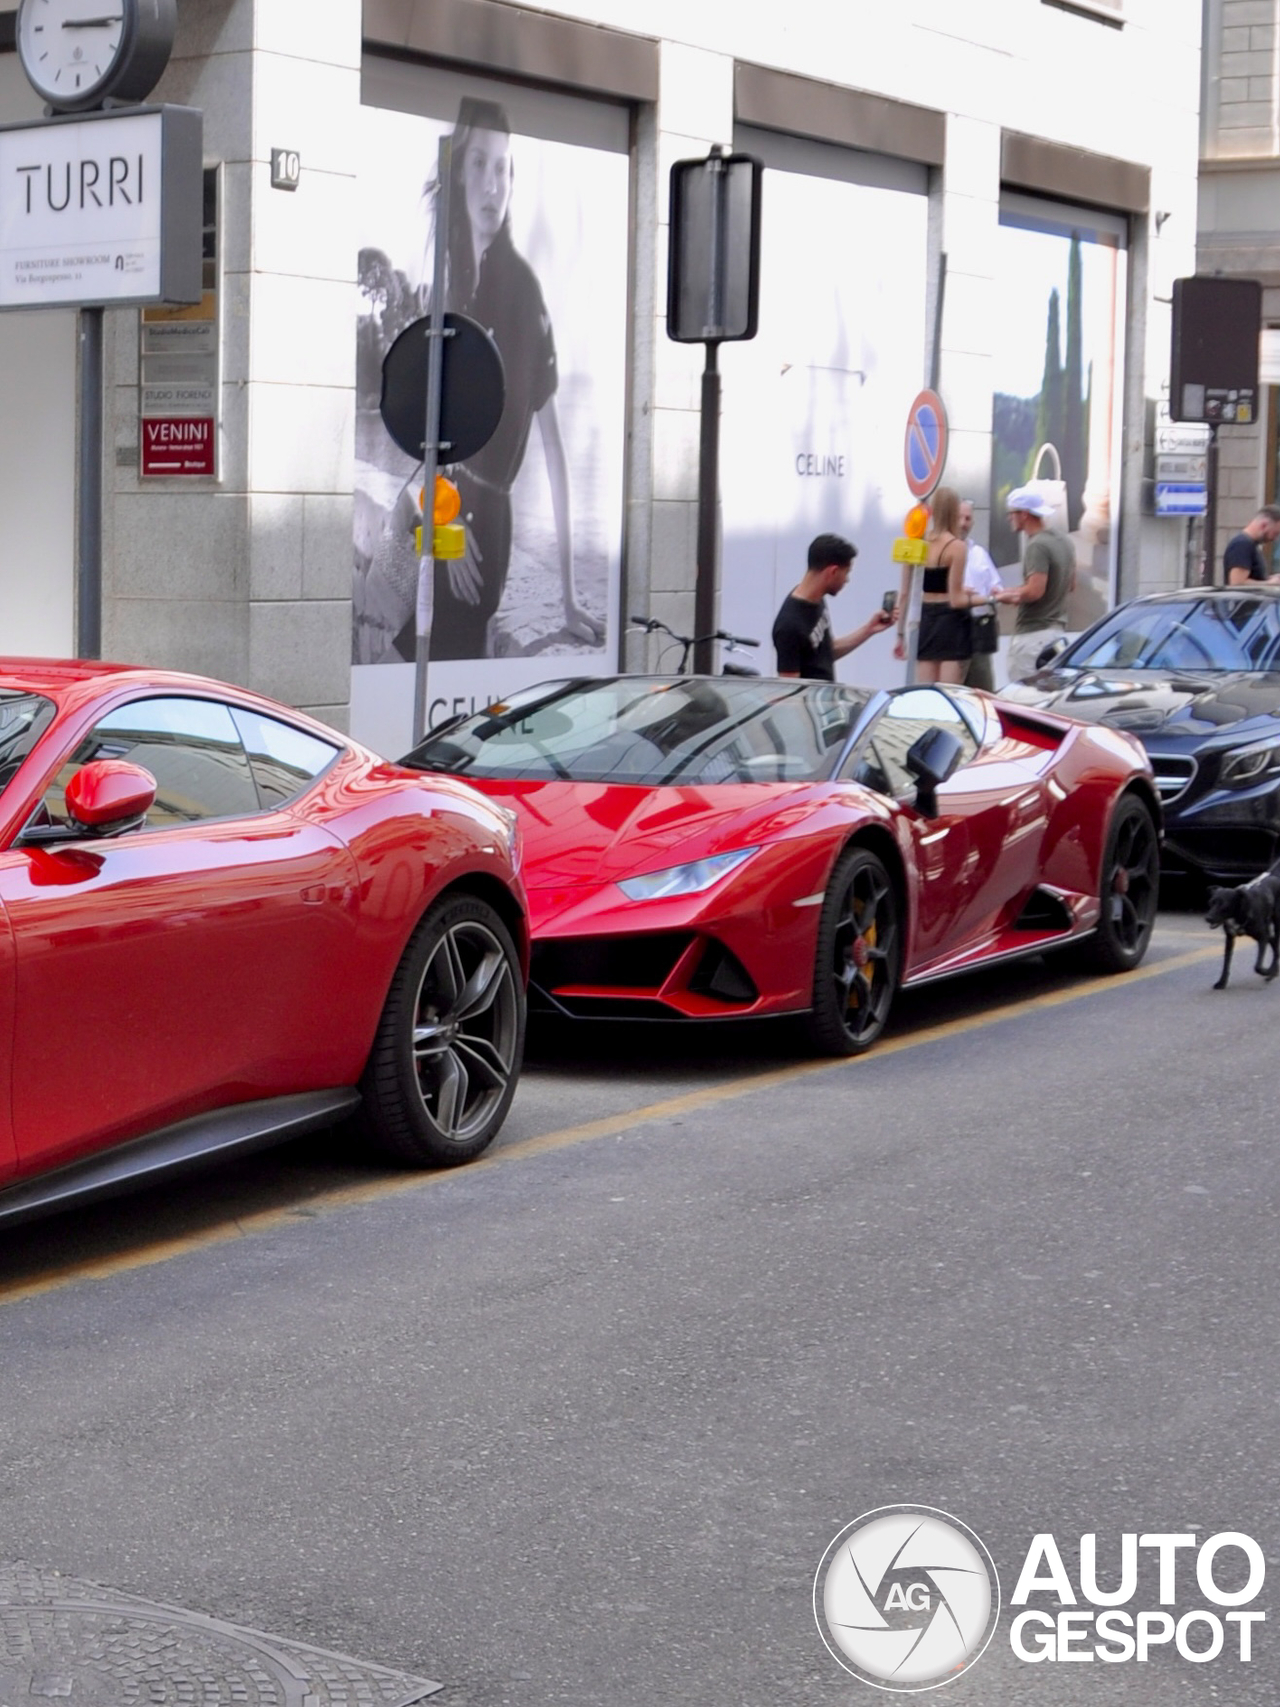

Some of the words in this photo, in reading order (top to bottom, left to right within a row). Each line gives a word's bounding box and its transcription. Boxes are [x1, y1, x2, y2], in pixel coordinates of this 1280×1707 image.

[278, 151, 299, 180] 10
[17, 154, 142, 214] TURRI
[15, 259, 60, 270] FURNITURE
[62, 255, 110, 267] SHOWROOM
[145, 390, 173, 400] STUDIO
[147, 423, 208, 441] VENINI
[796, 453, 845, 477] CELINE
